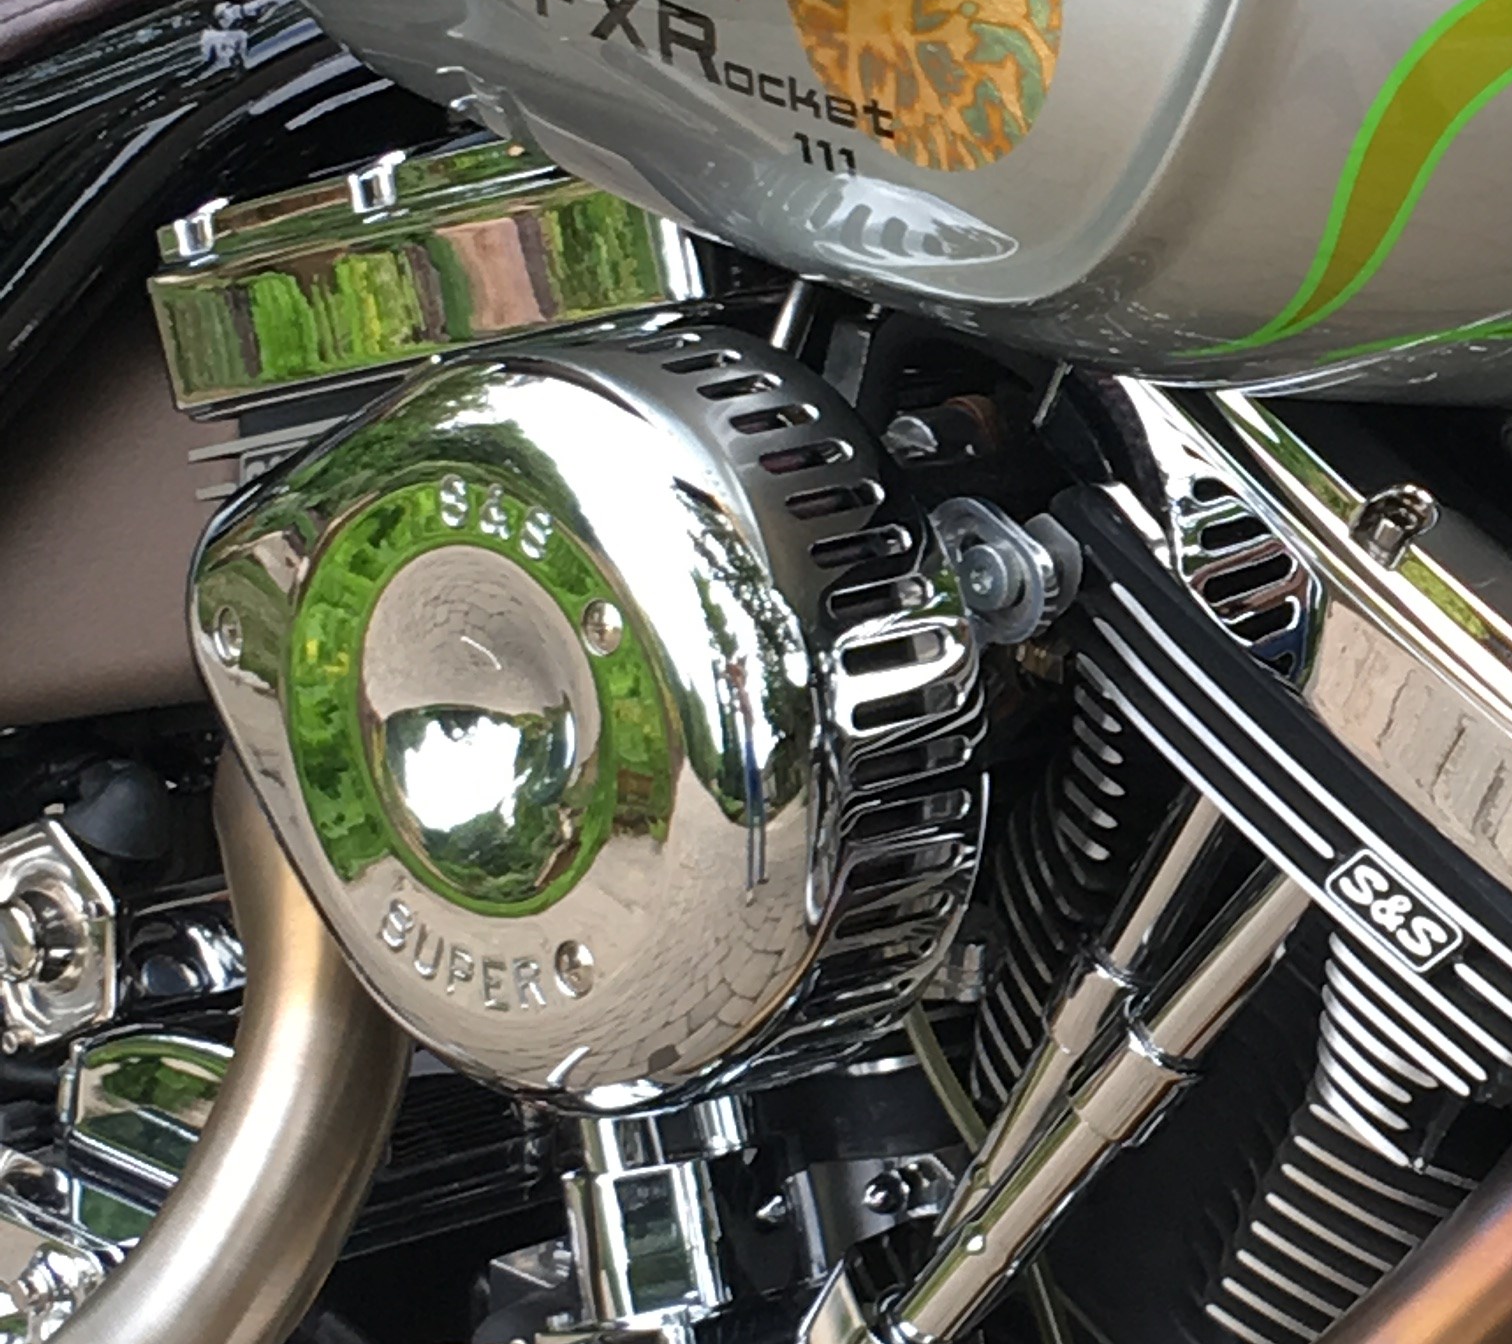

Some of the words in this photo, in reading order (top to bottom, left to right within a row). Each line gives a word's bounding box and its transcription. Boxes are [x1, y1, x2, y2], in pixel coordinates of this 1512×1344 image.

[794, 132, 856, 175] 111
[440, 473, 553, 561] S&S
[379, 898, 549, 1012] SUPER
[1338, 864, 1448, 957] S&S
